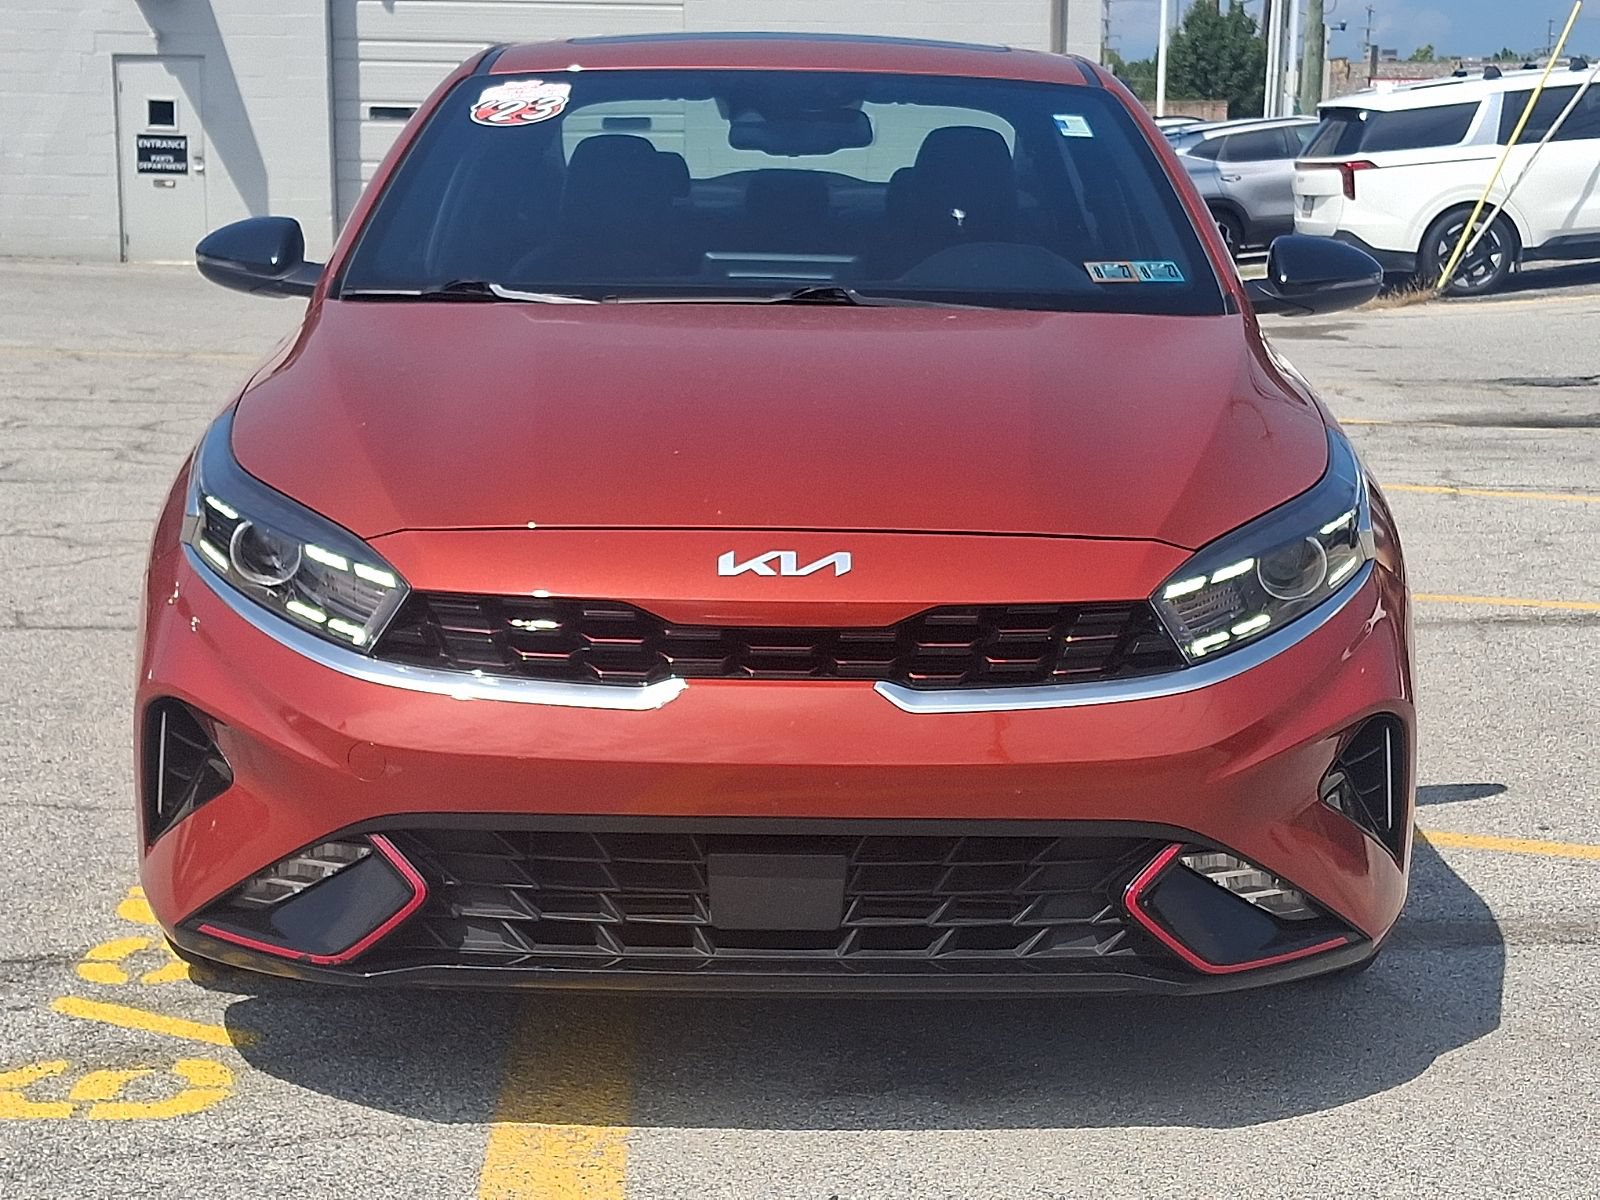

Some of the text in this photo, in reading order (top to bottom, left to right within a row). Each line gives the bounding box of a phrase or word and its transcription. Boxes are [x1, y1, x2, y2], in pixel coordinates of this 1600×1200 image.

[138, 139, 185, 149] ENTRANCE
[138, 161, 187, 171] DEPARTMENT
[717, 550, 852, 577] KIA
